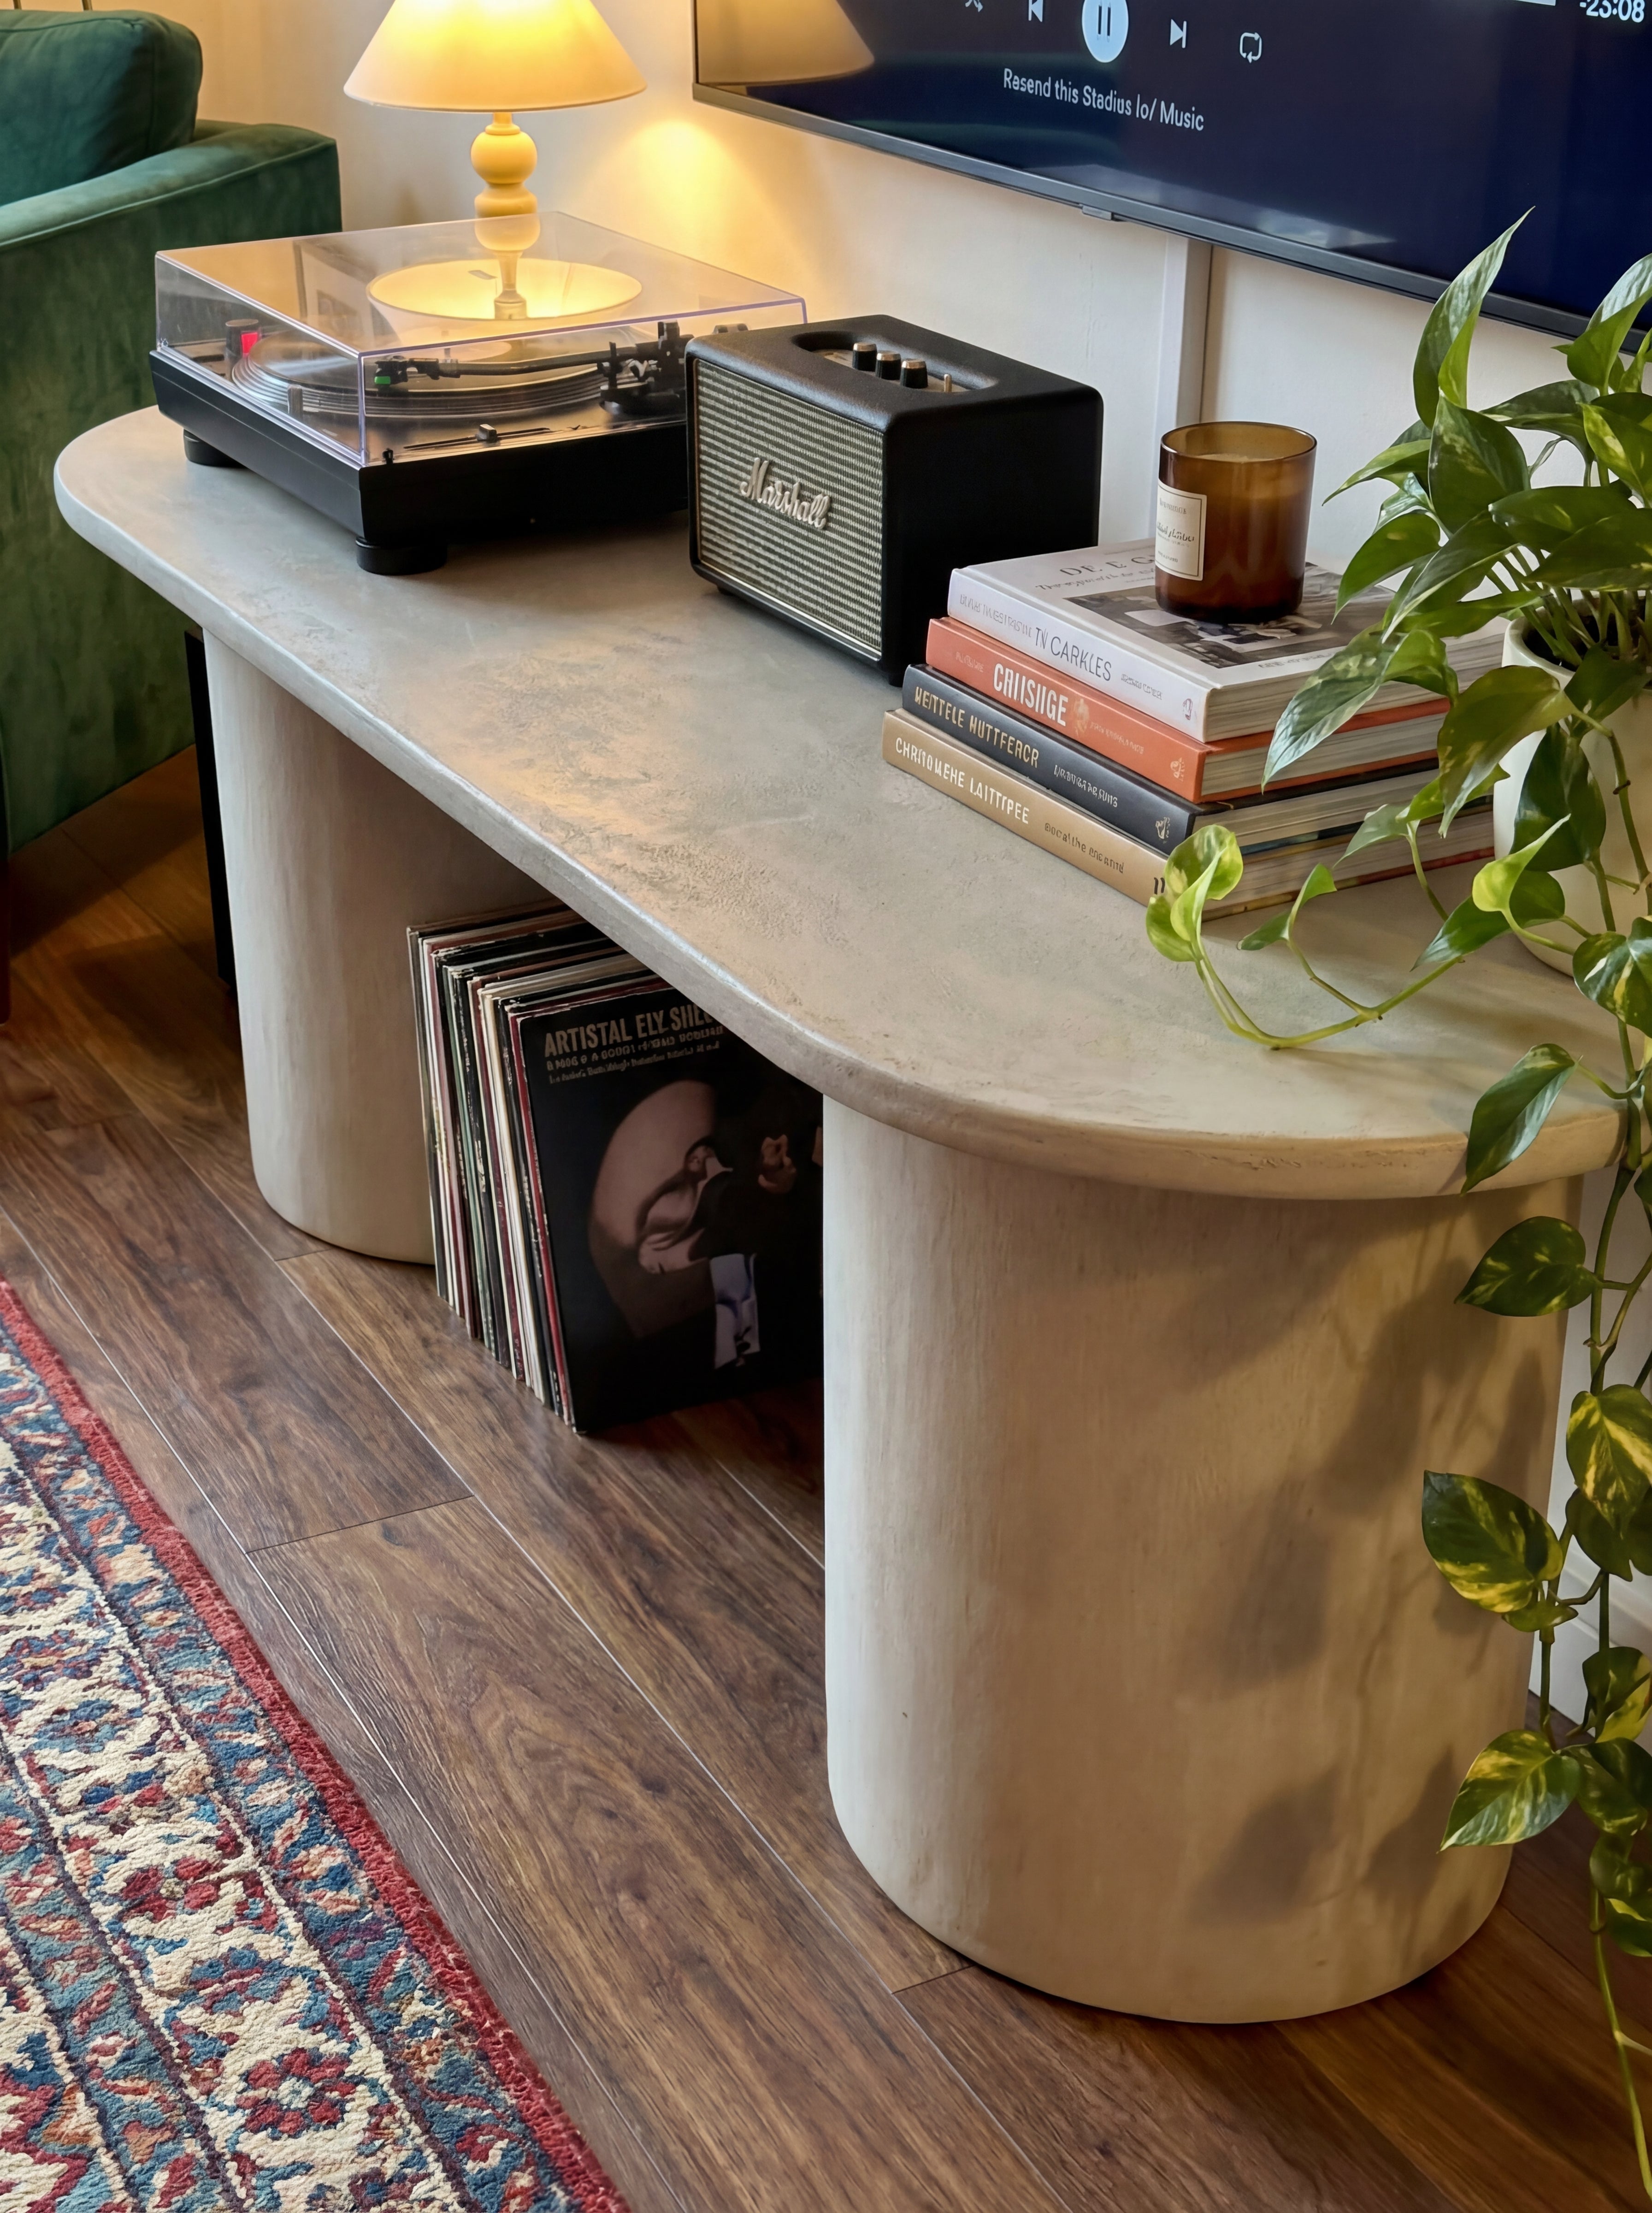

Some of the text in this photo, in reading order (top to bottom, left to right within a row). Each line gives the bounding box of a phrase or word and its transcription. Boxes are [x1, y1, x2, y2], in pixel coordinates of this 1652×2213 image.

[1055, 78, 1079, 104] this
[1083, 85, 1132, 116] Stadius
[1160, 100, 1204, 131] Music
[740, 457, 830, 530] Marshall
[544, 1018, 633, 1058] ARTISTAL
